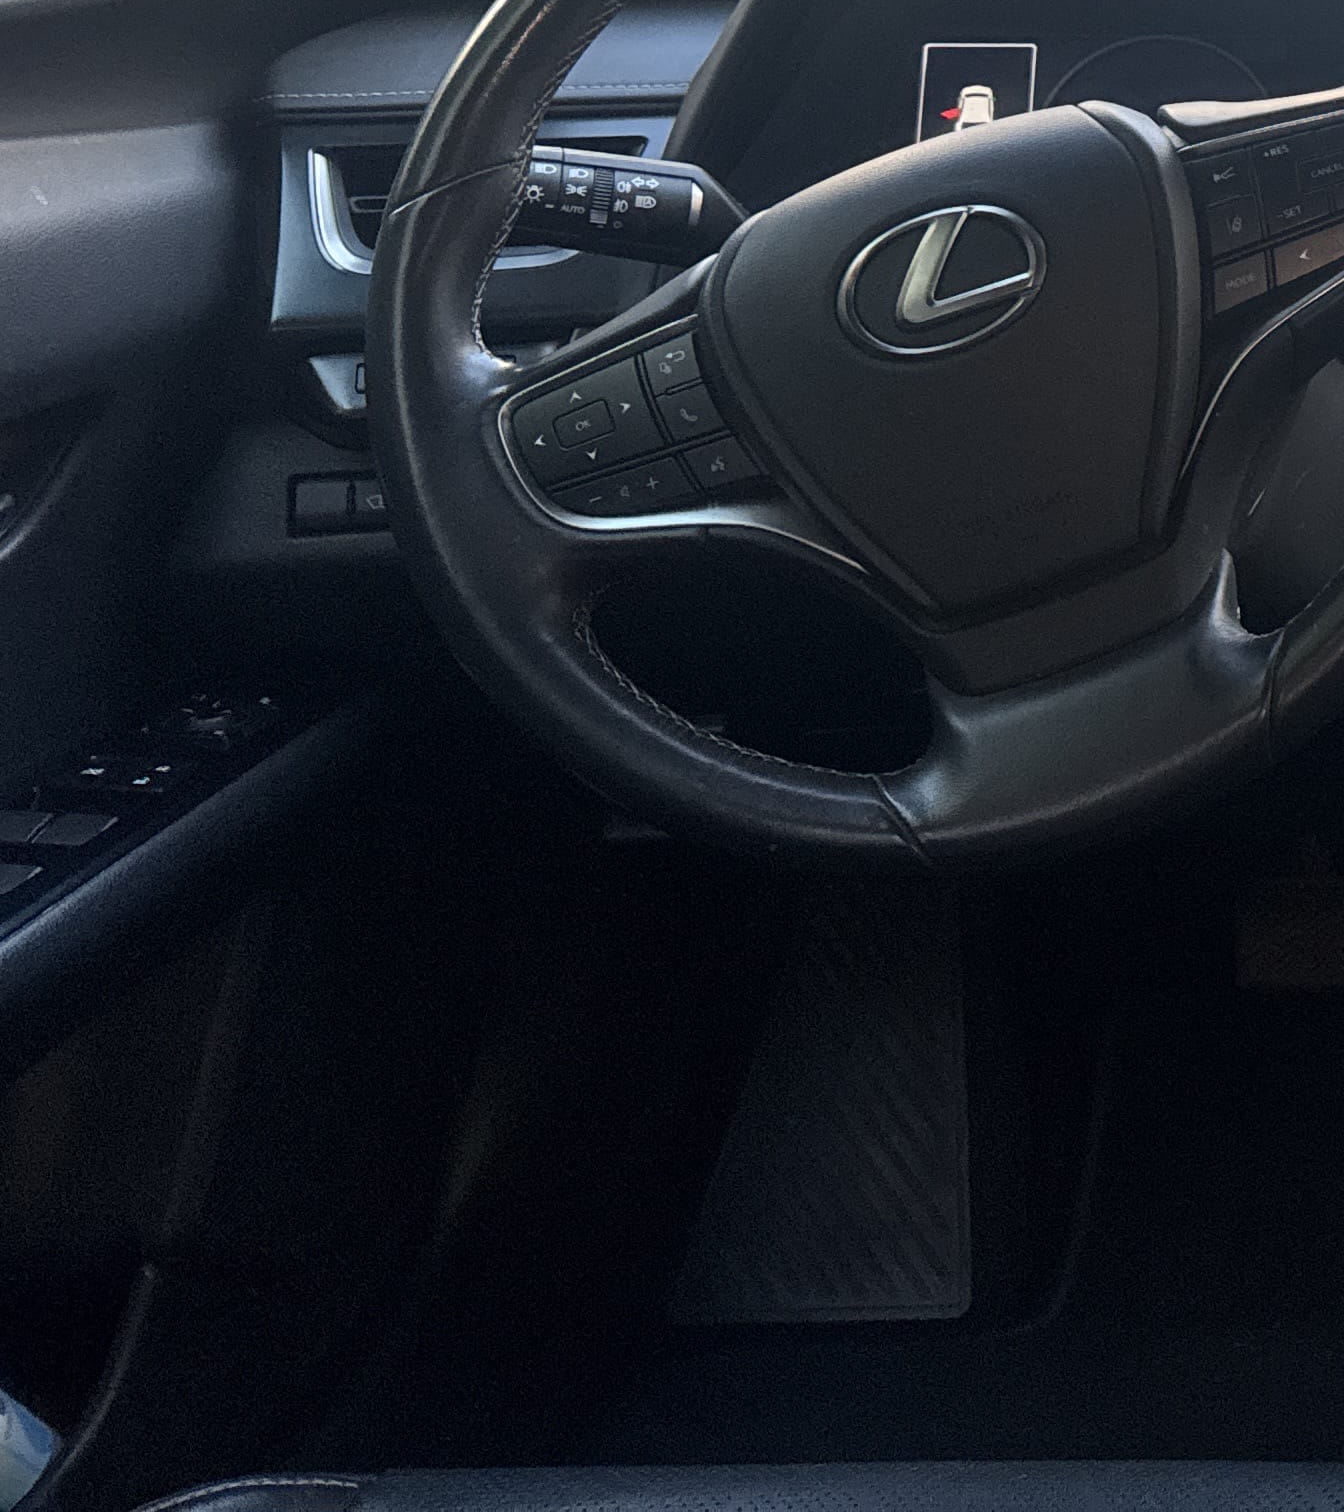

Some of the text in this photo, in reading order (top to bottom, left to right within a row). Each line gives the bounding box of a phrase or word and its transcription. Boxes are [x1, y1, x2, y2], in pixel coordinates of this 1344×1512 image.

[1309, 162, 1344, 179] CANCEL
[560, 203, 586, 215] AUTO
[1225, 273, 1258, 291] MODE
[575, 418, 592, 432] OK
